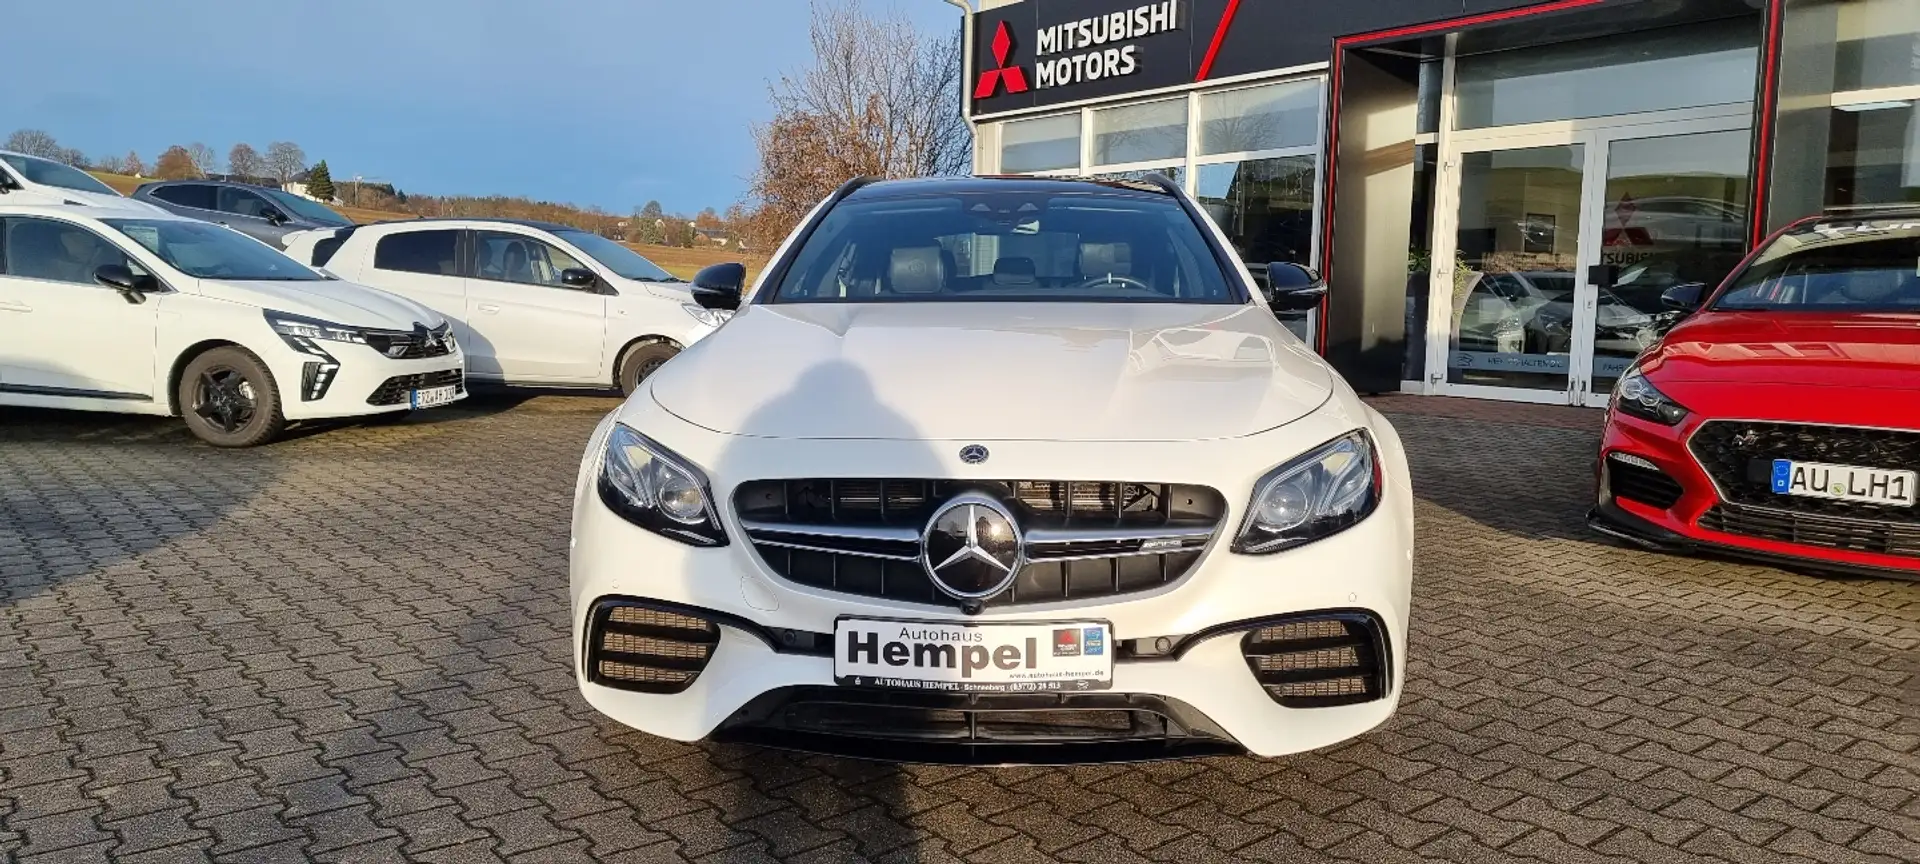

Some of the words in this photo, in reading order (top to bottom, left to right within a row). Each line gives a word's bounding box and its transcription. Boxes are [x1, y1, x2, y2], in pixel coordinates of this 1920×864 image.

[1035, 0, 1178, 55] MITSUBISHI
[1035, 44, 1136, 89] MOTORS
[1790, 466, 1830, 492] AU
[1847, 472, 1908, 500] LH1
[899, 626, 983, 642] Autohaus
[847, 630, 1037, 679] Hempel
[874, 678, 921, 689] AUTOHAUS
[922, 680, 960, 691] HEMPEL
